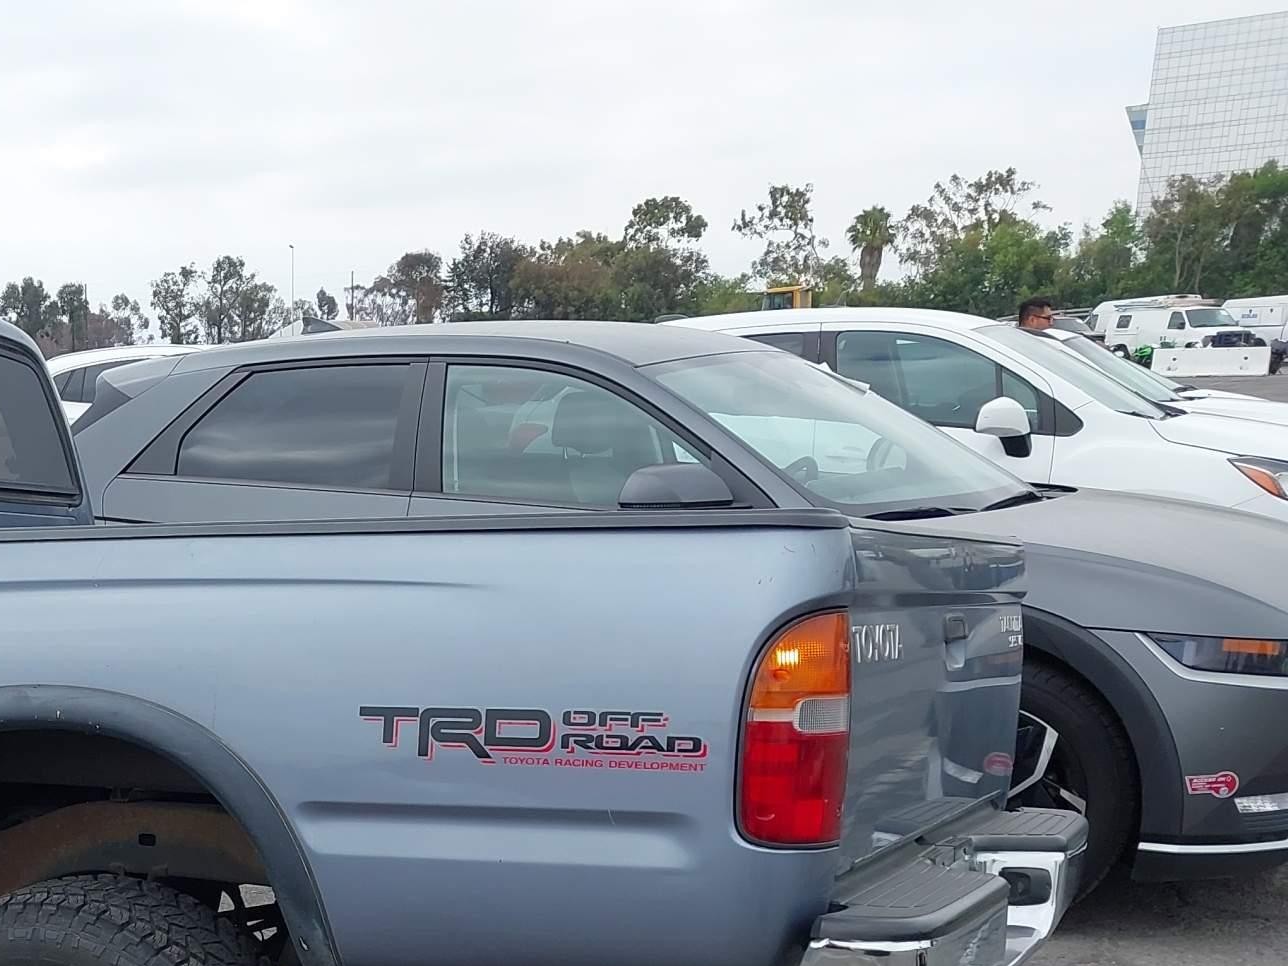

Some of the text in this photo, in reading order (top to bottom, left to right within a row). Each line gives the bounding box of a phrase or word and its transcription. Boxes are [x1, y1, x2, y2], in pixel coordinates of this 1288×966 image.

[852, 624, 903, 663] TOYOTA
[562, 711, 669, 733] OFF
[359, 706, 556, 763] TRD
[560, 734, 708, 758] ROAD
[503, 756, 706, 772] TOYOTA RACING DEVELOPMENT
